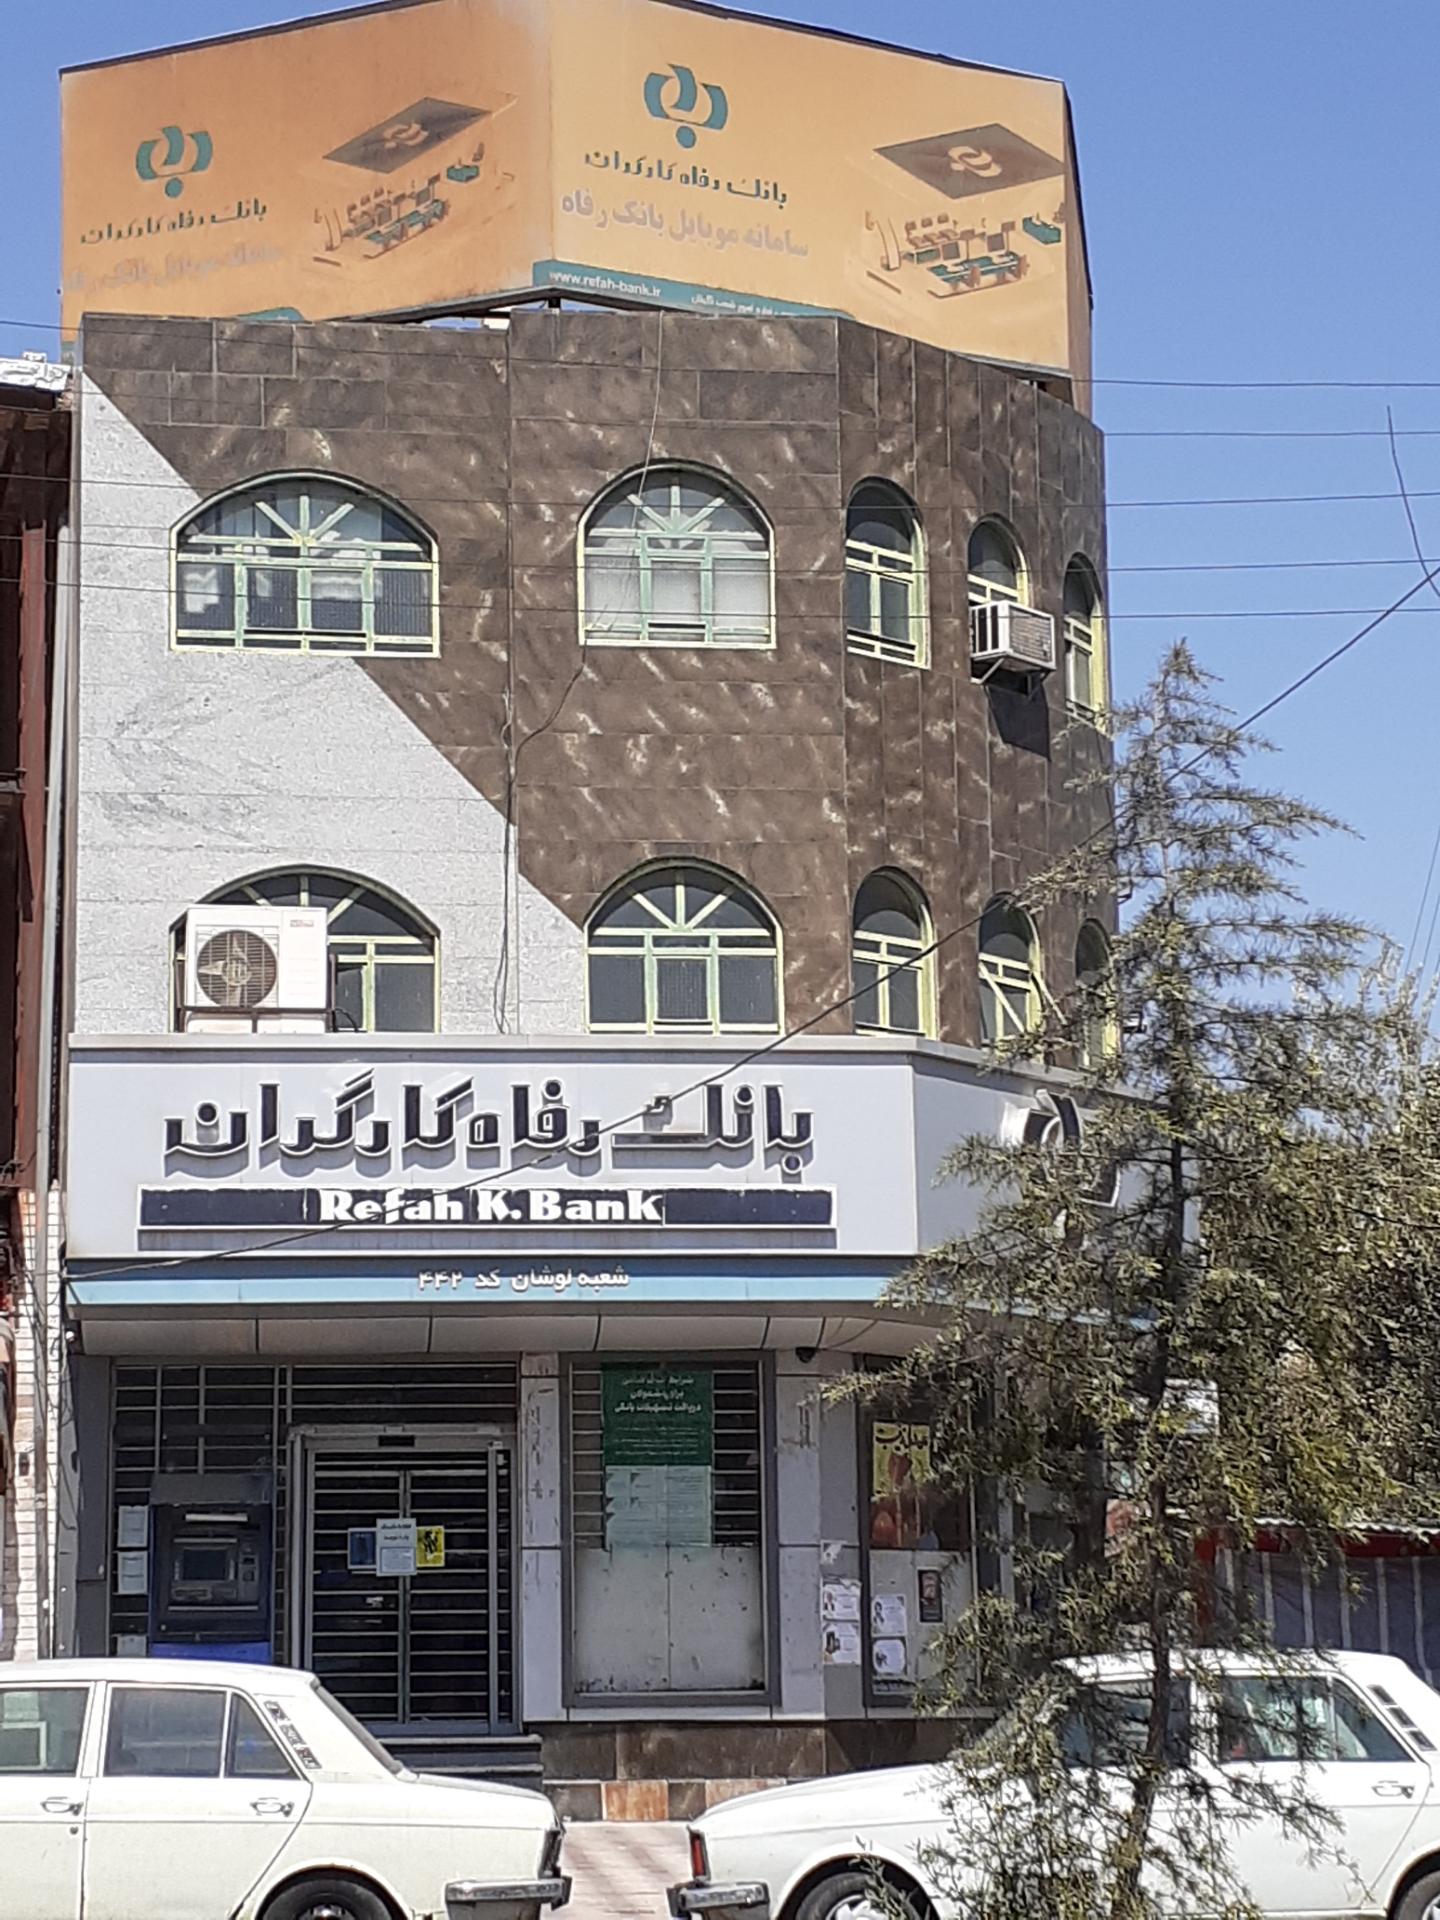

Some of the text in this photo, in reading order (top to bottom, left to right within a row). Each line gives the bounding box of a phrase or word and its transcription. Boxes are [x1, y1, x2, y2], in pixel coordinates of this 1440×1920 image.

[680, 166, 720, 190] رفاه
[727, 179, 786, 210] بانک
[164, 1067, 814, 1174] بانک رفاه کارگران
[319, 1187, 464, 1224] Refah
[478, 1189, 522, 1221] K.
[474, 1268, 501, 1288] کد
[577, 1264, 630, 1291] شعبه
